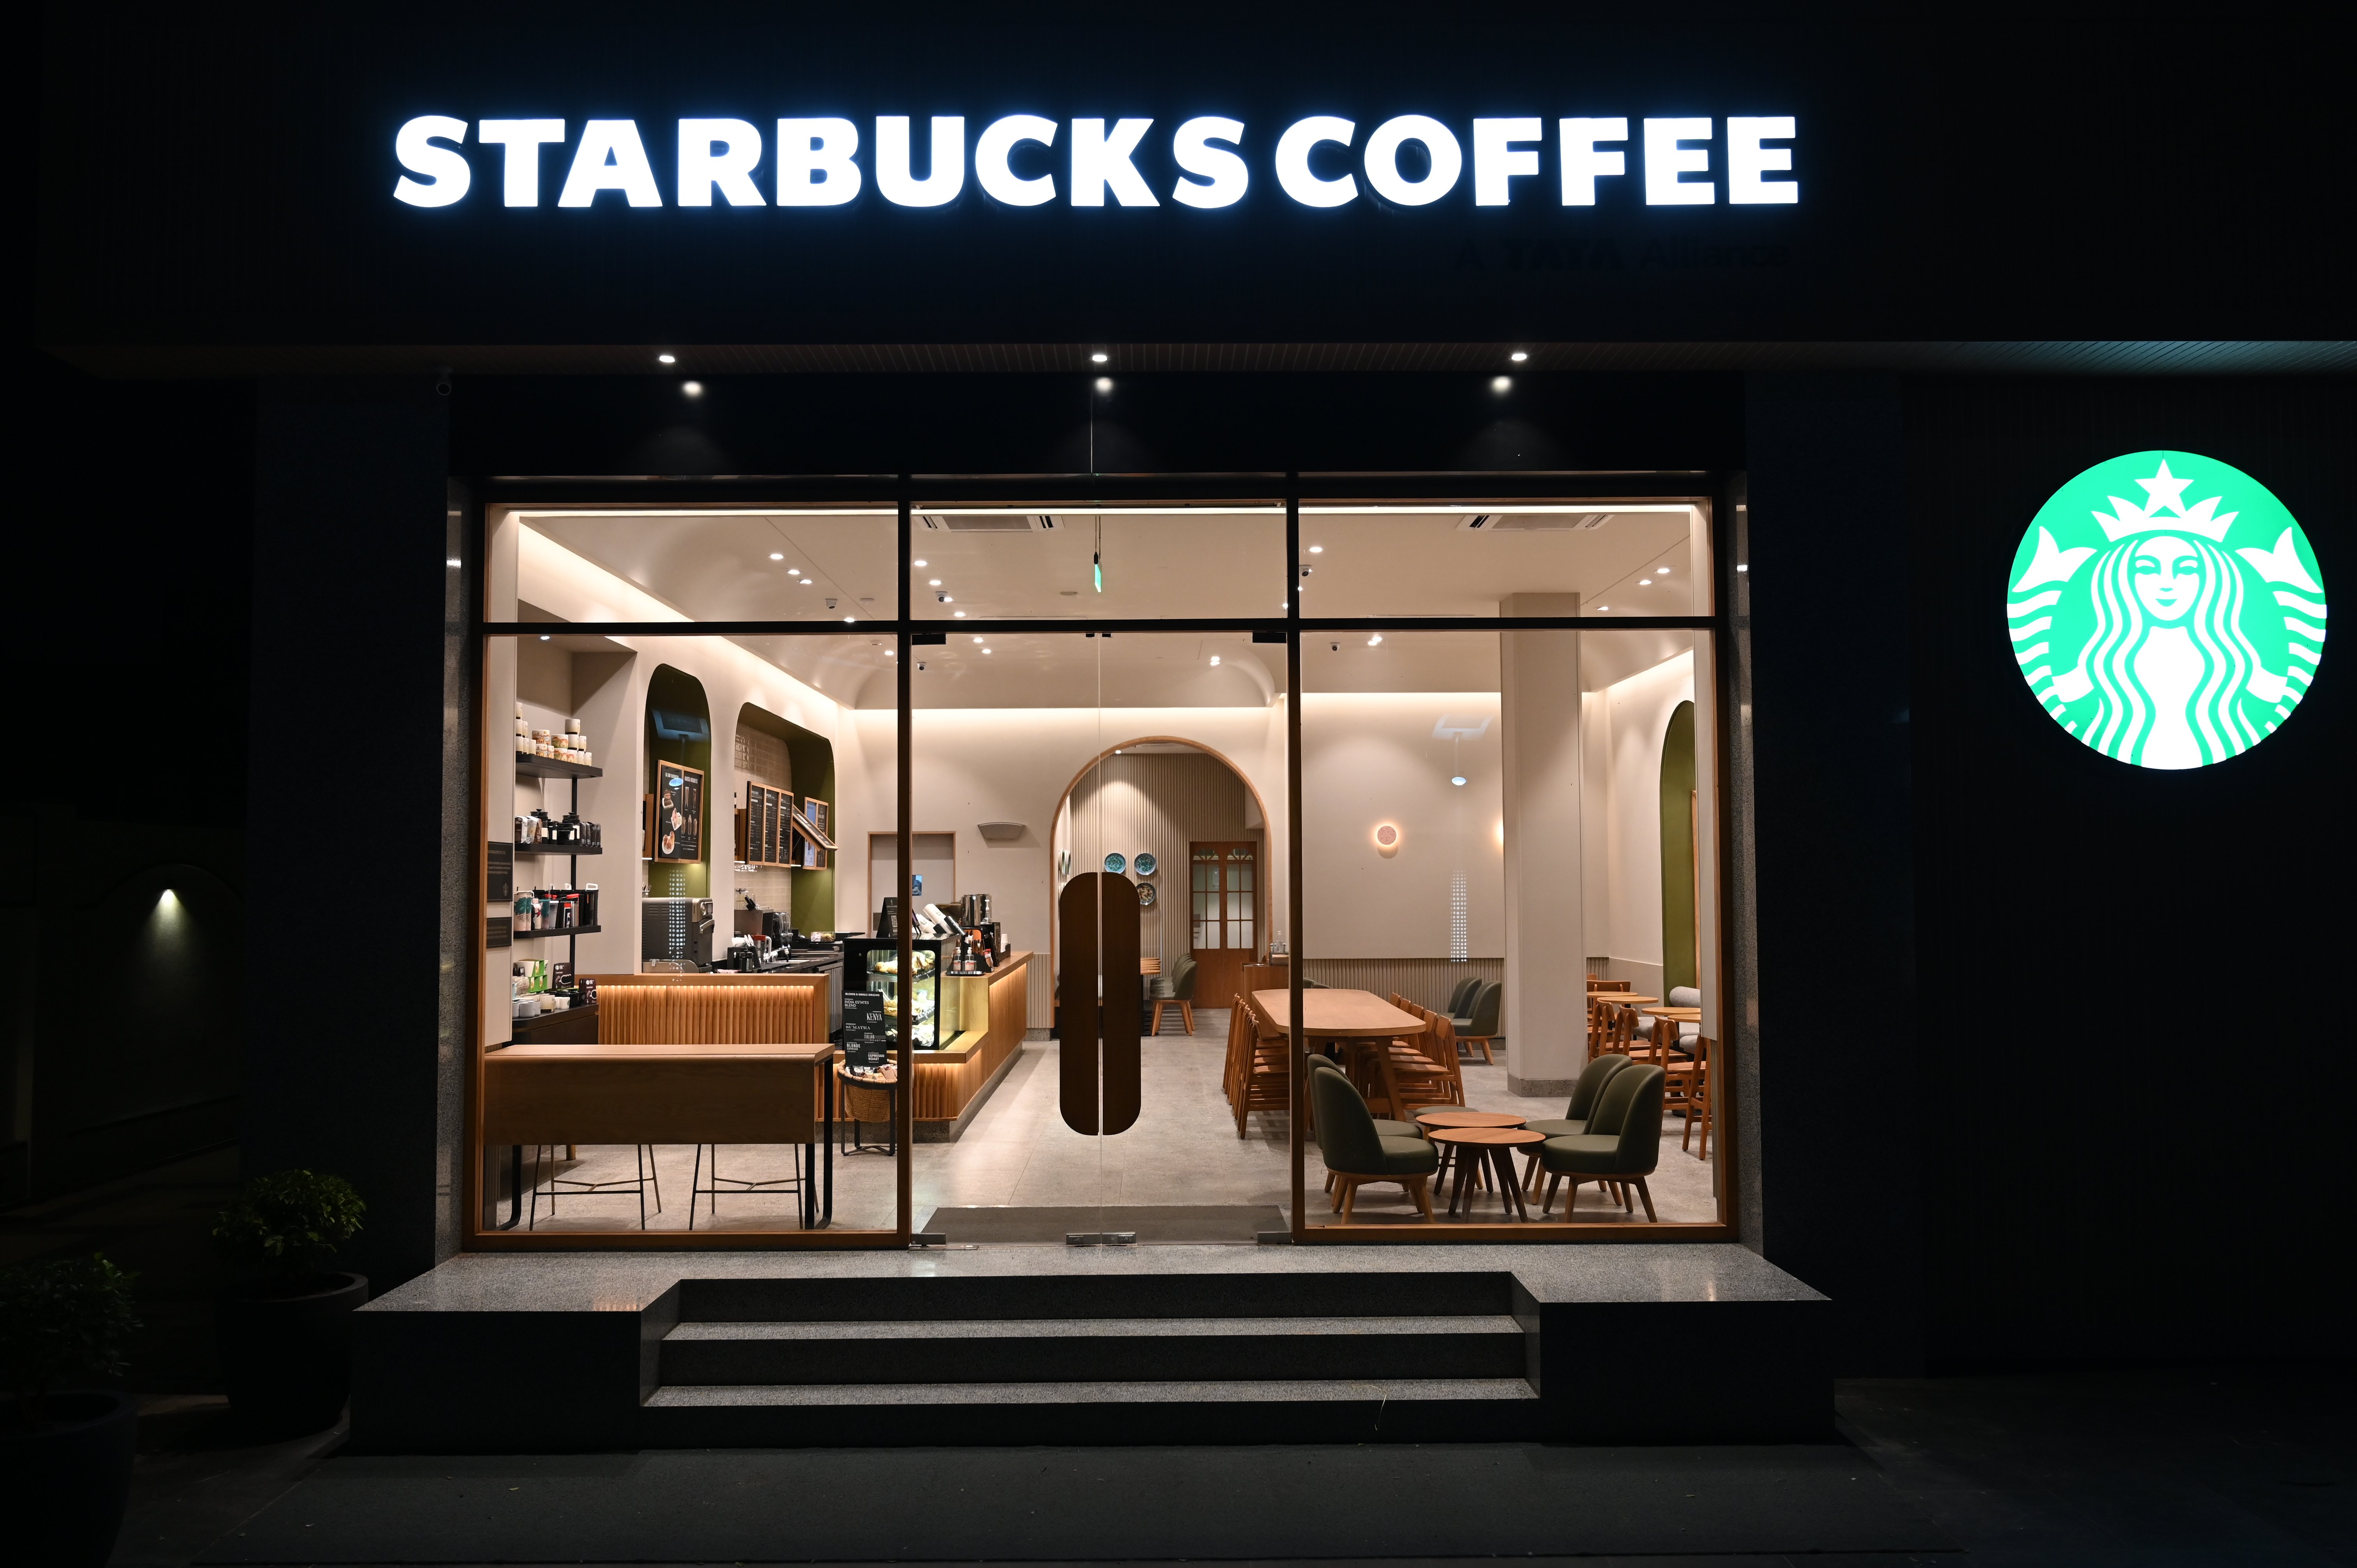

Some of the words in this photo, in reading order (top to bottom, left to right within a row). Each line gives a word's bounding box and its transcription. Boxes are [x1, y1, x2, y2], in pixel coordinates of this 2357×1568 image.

[394, 115, 1248, 208] STARBUCKS
[1276, 115, 1797, 207] COFFEE
[1454, 238, 1485, 270] A
[1498, 238, 1624, 270] TATA
[1639, 235, 1790, 270] Alliance
